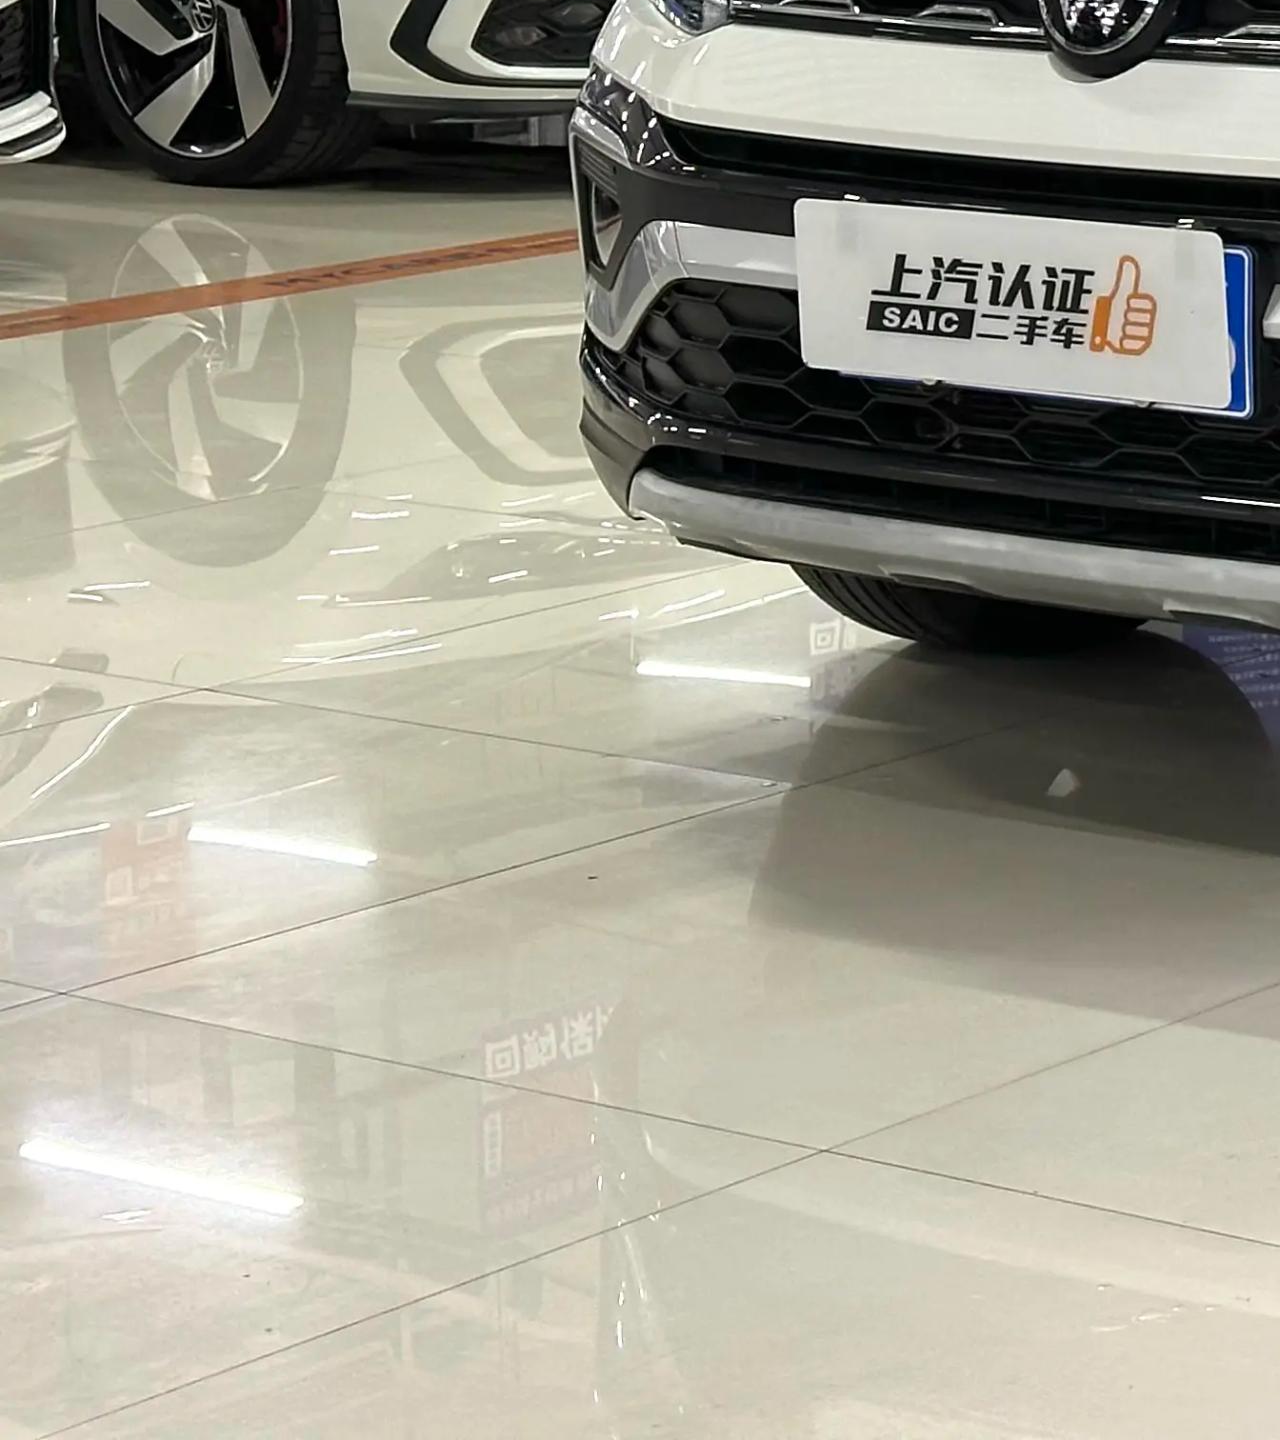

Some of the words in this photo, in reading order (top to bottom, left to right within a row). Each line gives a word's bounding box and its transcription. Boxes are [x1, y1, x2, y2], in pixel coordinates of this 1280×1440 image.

[870, 253, 1096, 315] 上汽认证
[880, 305, 961, 334] SAIC
[975, 312, 1087, 350] 二手车
